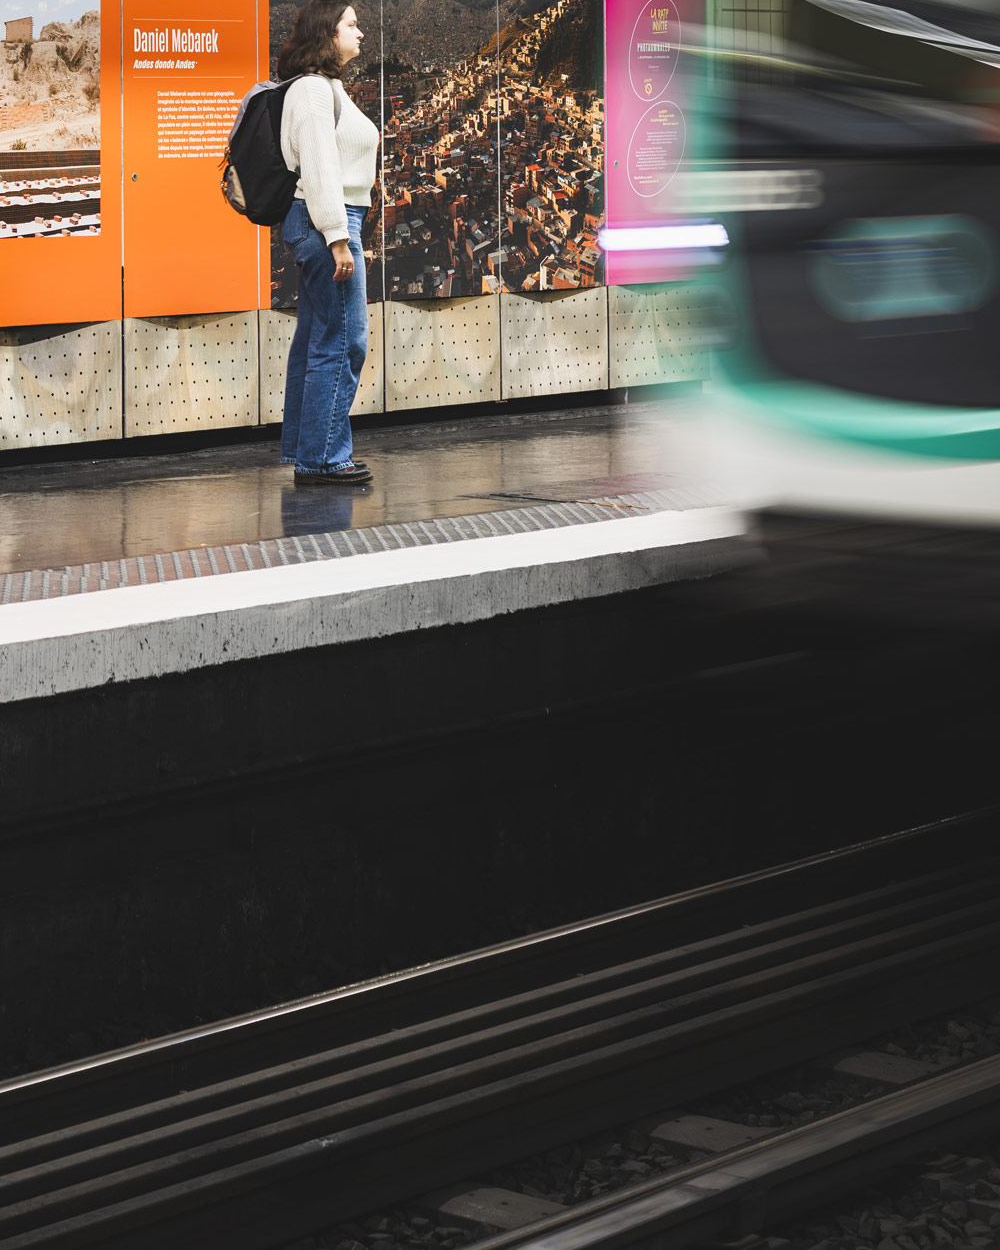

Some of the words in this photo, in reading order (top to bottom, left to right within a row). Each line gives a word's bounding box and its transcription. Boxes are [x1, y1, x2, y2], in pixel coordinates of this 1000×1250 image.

[133, 28, 169, 53] Daniel
[172, 28, 219, 53] Mebarek
[133, 59, 153, 69] Andes
[155, 59, 175, 69] donde
